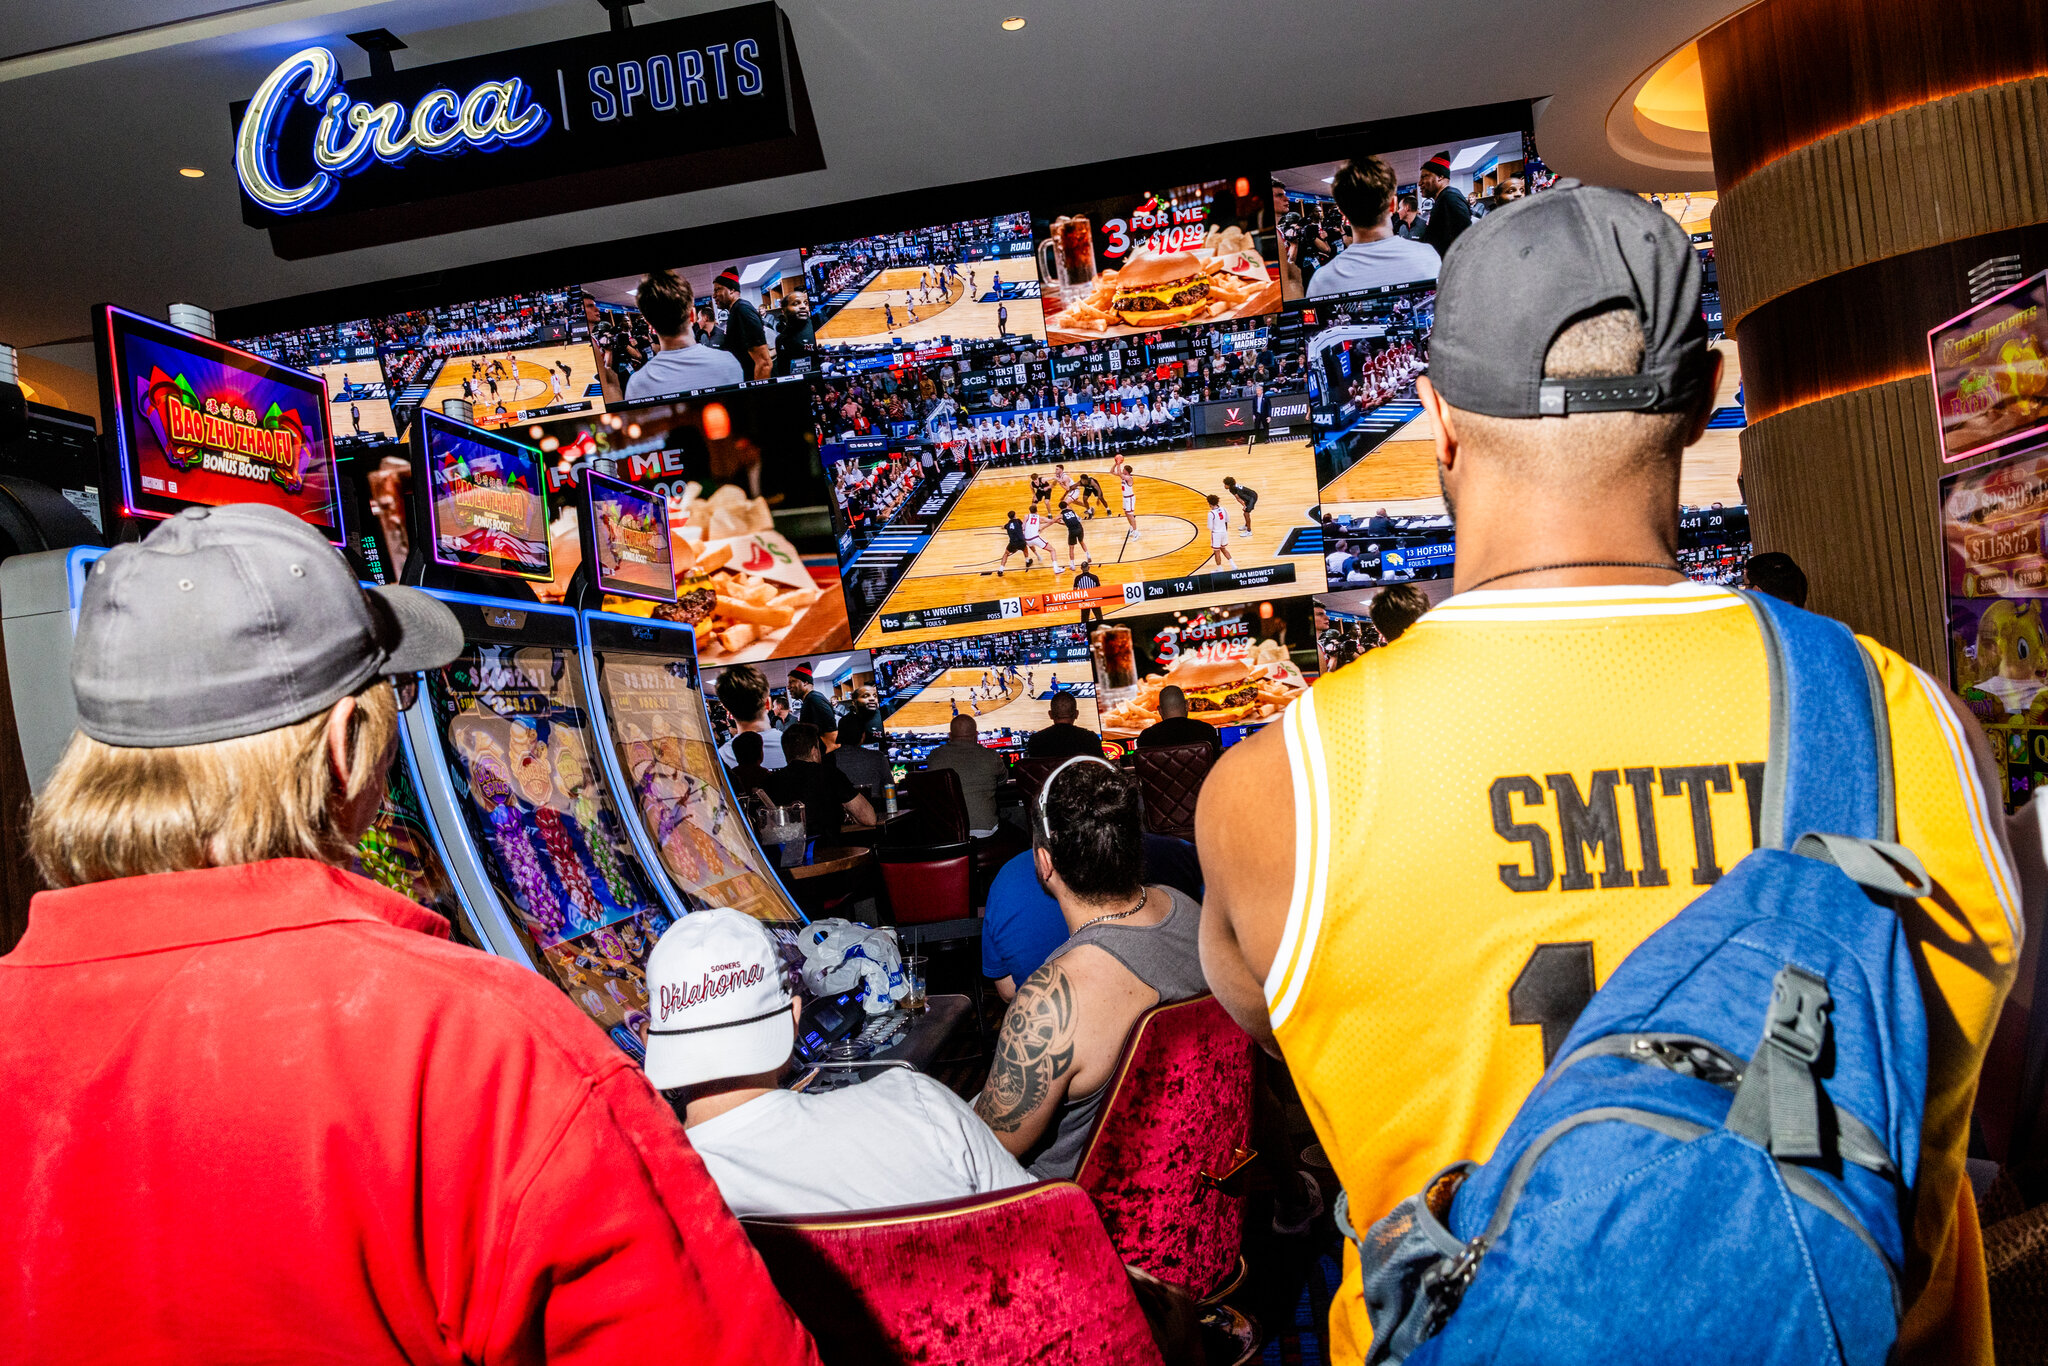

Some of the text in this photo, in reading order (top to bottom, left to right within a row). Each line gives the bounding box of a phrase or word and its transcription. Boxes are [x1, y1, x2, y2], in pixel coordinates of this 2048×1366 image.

[235, 38, 764, 213] Circa SPORTS
[1101, 206, 1204, 258] 3 FOR ME
[1010, 241, 1032, 251] ROAD
[1707, 312, 1722, 322] LG
[1985, 305, 2037, 344] JACKPOTS
[1201, 338, 1208, 346] ET
[1230, 331, 1255, 342] MARCH
[1234, 337, 1267, 349] MADNESS
[354, 346, 374, 356] ROAD
[1089, 354, 1103, 363] HOF
[1110, 351, 1119, 360] 30
[1195, 348, 1207, 356] TBS
[1090, 364, 1103, 373] ALA
[1111, 361, 1121, 369] 23
[1126, 357, 1141, 366] 4:35
[994, 367, 1005, 377] TEN
[1005, 366, 1013, 375] ST
[1016, 364, 1024, 373] 21
[1031, 372, 1046, 380] 2:40
[1003, 376, 1011, 385] ST
[1017, 374, 1026, 383] 46
[518, 411, 526, 420] 80
[1270, 403, 1307, 418] IRGINIA
[168, 395, 293, 467] BAO ZHU ZHAO FU
[222, 451, 251, 463] FEATURING
[202, 453, 271, 482] BONUS BOOST
[628, 449, 685, 481] ME
[454, 472, 473, 507] BAO
[473, 485, 492, 511] ZHU
[491, 490, 512, 516] ZHAO
[1218, 511, 1223, 520] 5
[1680, 515, 1722, 528] 4:41 20
[473, 514, 511, 532] BONUS BOOST
[1417, 544, 1453, 556] HOFSTRA
[1231, 568, 1274, 580] NCAA MIDWEST
[1247, 576, 1268, 585] ROUND
[1053, 590, 1089, 602] VIRGINIA
[1125, 581, 1193, 599] 80 2ND 19.4
[932, 606, 963, 618] WRIGHT
[963, 604, 972, 613] ST
[1003, 601, 1019, 615] 73
[1078, 601, 1096, 609] BONUS
[987, 612, 1000, 620] POSS
[881, 618, 899, 628] tbs
[1153, 622, 1249, 664] 3 FOR ME
[1067, 647, 1087, 657] ROAD
[1012, 736, 1021, 744] 23
[1010, 753, 1020, 763] 73
[475, 762, 508, 784] ULTRA
[483, 781, 509, 797] SPINS
[710, 961, 741, 973] SOONERS
[603, 979, 629, 1006] K
[659, 963, 765, 1023] Oklahoma
[581, 989, 607, 1017] 10
